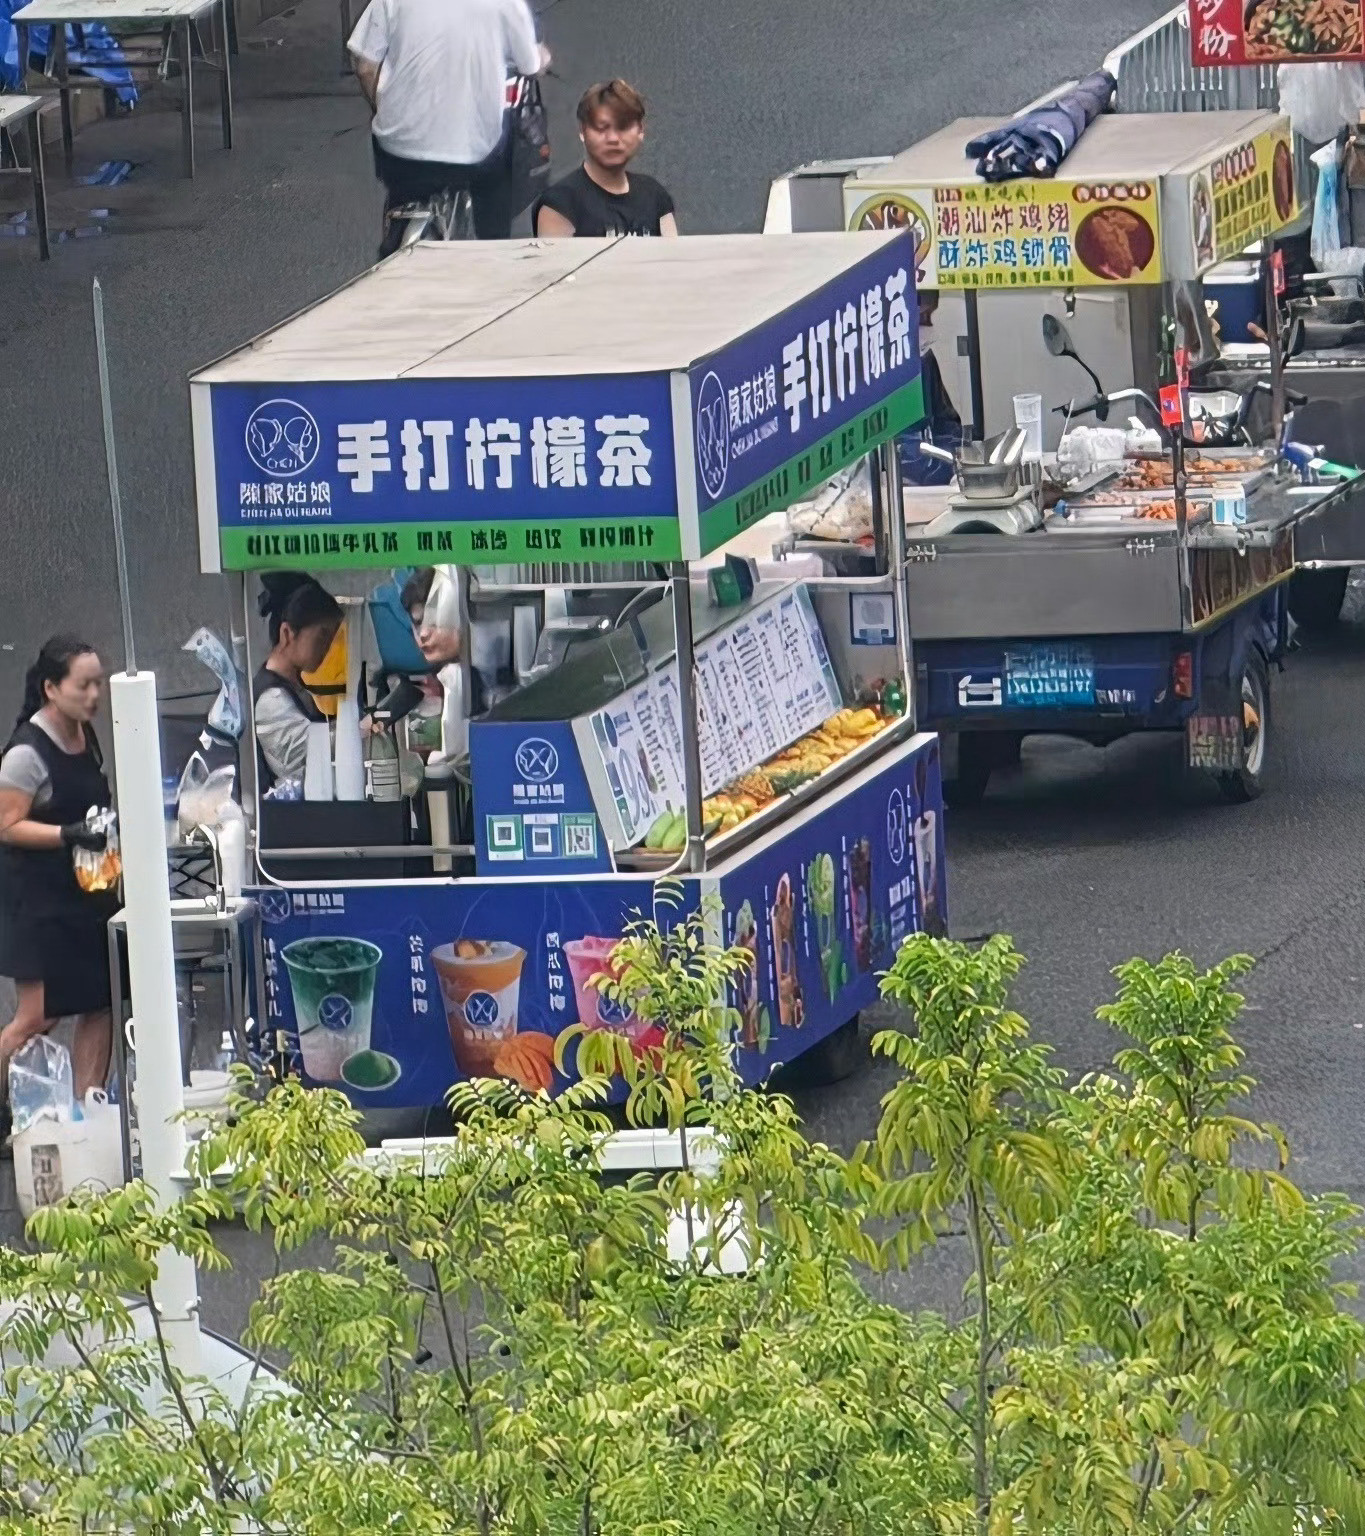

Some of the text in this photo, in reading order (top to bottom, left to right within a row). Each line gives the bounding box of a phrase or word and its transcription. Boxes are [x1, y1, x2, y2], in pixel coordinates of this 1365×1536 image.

[783, 268, 911, 433] 手打柠檬茶
[337, 415, 653, 493] 手打柠檬茶
